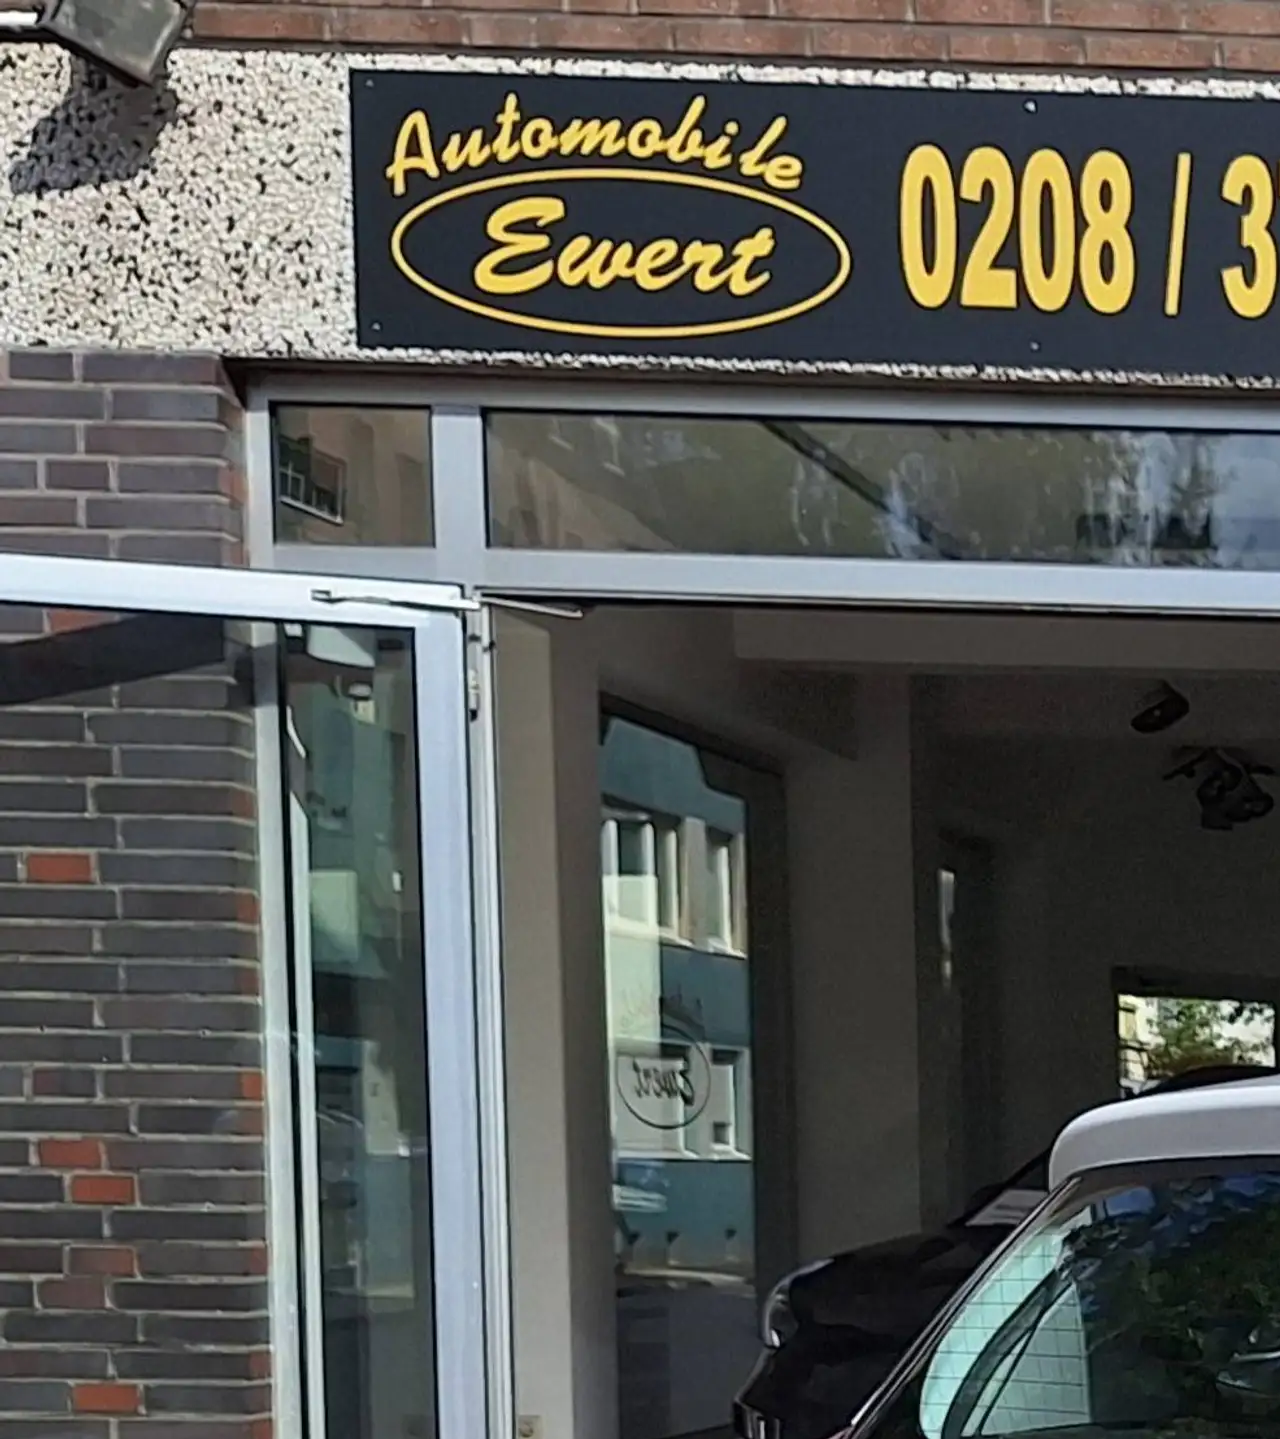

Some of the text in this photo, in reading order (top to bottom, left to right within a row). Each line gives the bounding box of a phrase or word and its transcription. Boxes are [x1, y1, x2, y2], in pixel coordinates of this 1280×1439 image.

[386, 92, 803, 195] Automobile
[474, 197, 775, 296] Ewert
[899, 144, 1136, 315] 0208
[1164, 152, 1191, 316] /
